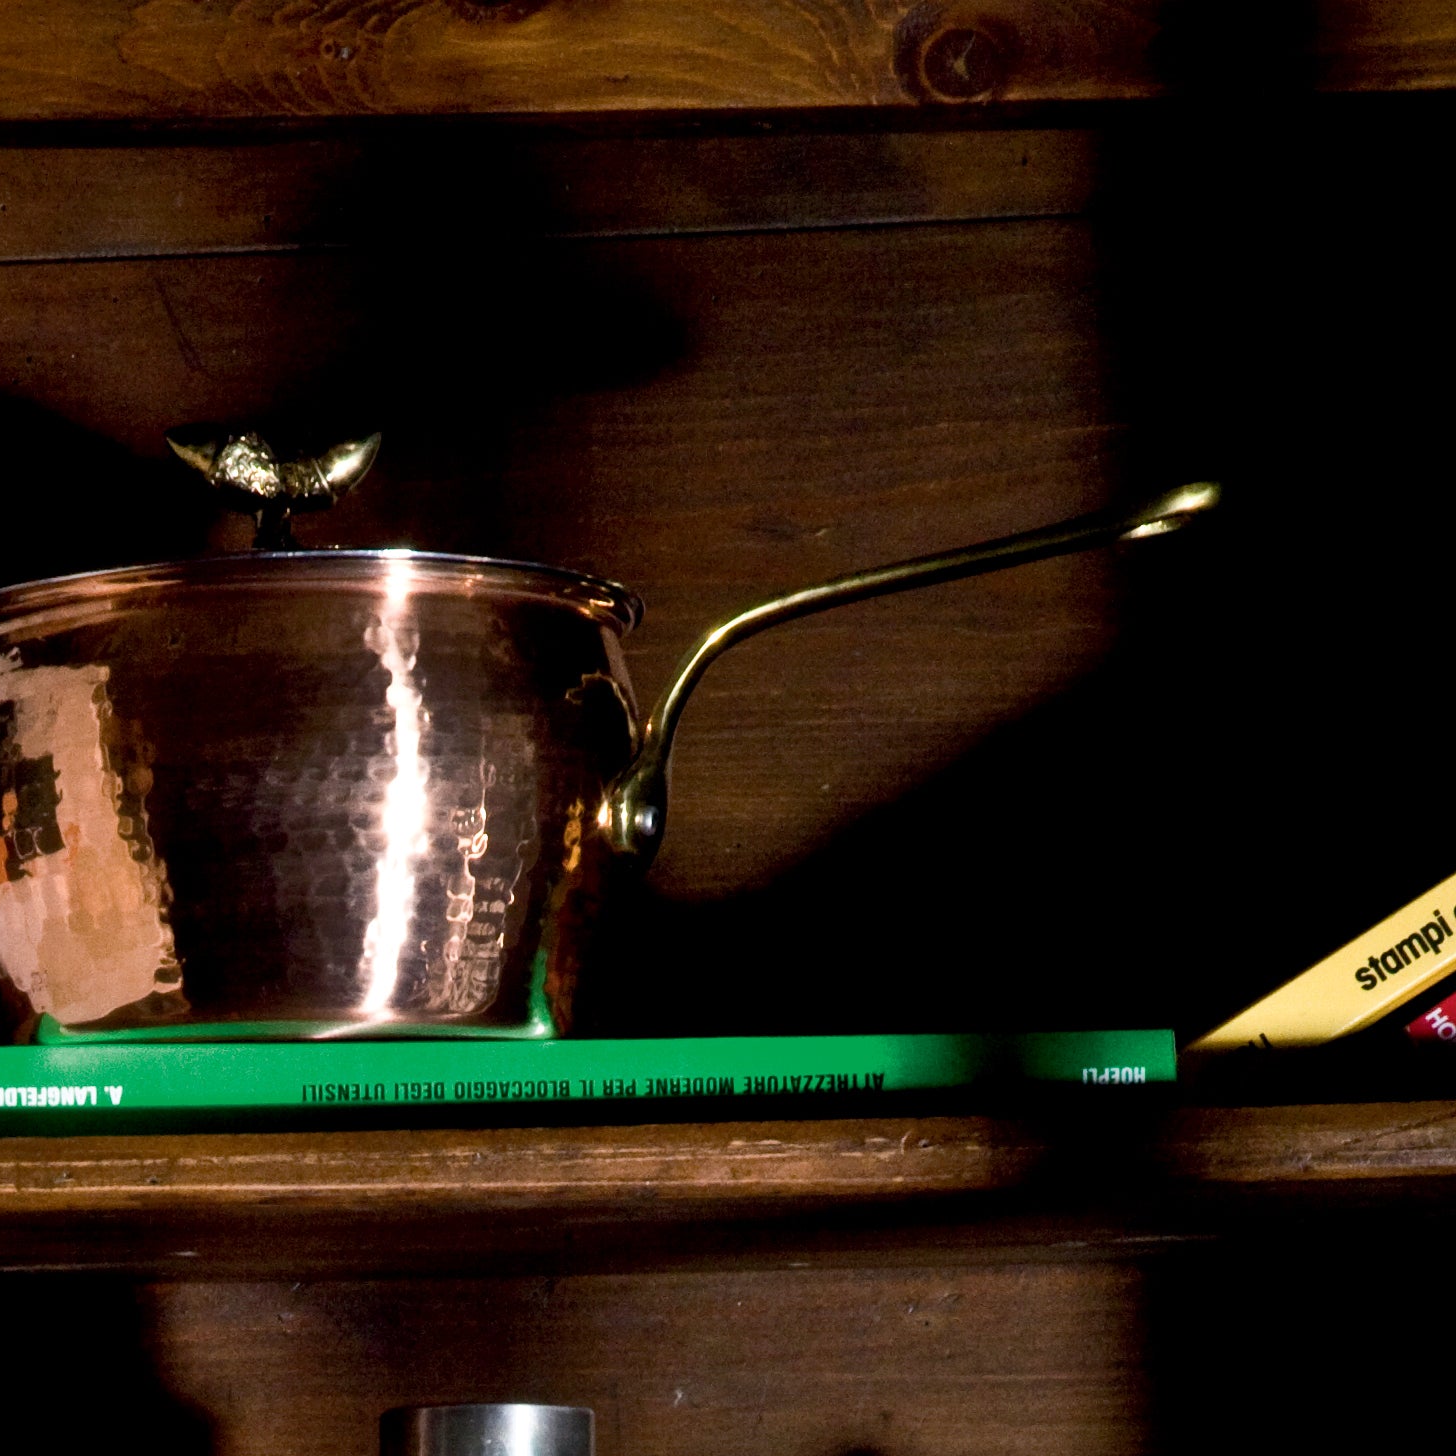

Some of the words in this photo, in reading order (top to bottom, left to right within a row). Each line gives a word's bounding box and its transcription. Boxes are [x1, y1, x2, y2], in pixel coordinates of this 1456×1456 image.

[1355, 909, 1453, 991] stampi
[744, 1073, 885, 1093] ATTREZZATURE
[1083, 1066, 1146, 1084] HOEPLI
[104, 1085, 123, 1105] A.
[302, 1083, 385, 1101] UTENSILI
[394, 1082, 445, 1100] DEGLI
[454, 1080, 571, 1099] BLOCCAGGIO
[579, 1080, 595, 1098] IL
[603, 1079, 637, 1097] PER
[646, 1076, 735, 1096] MODERNE
